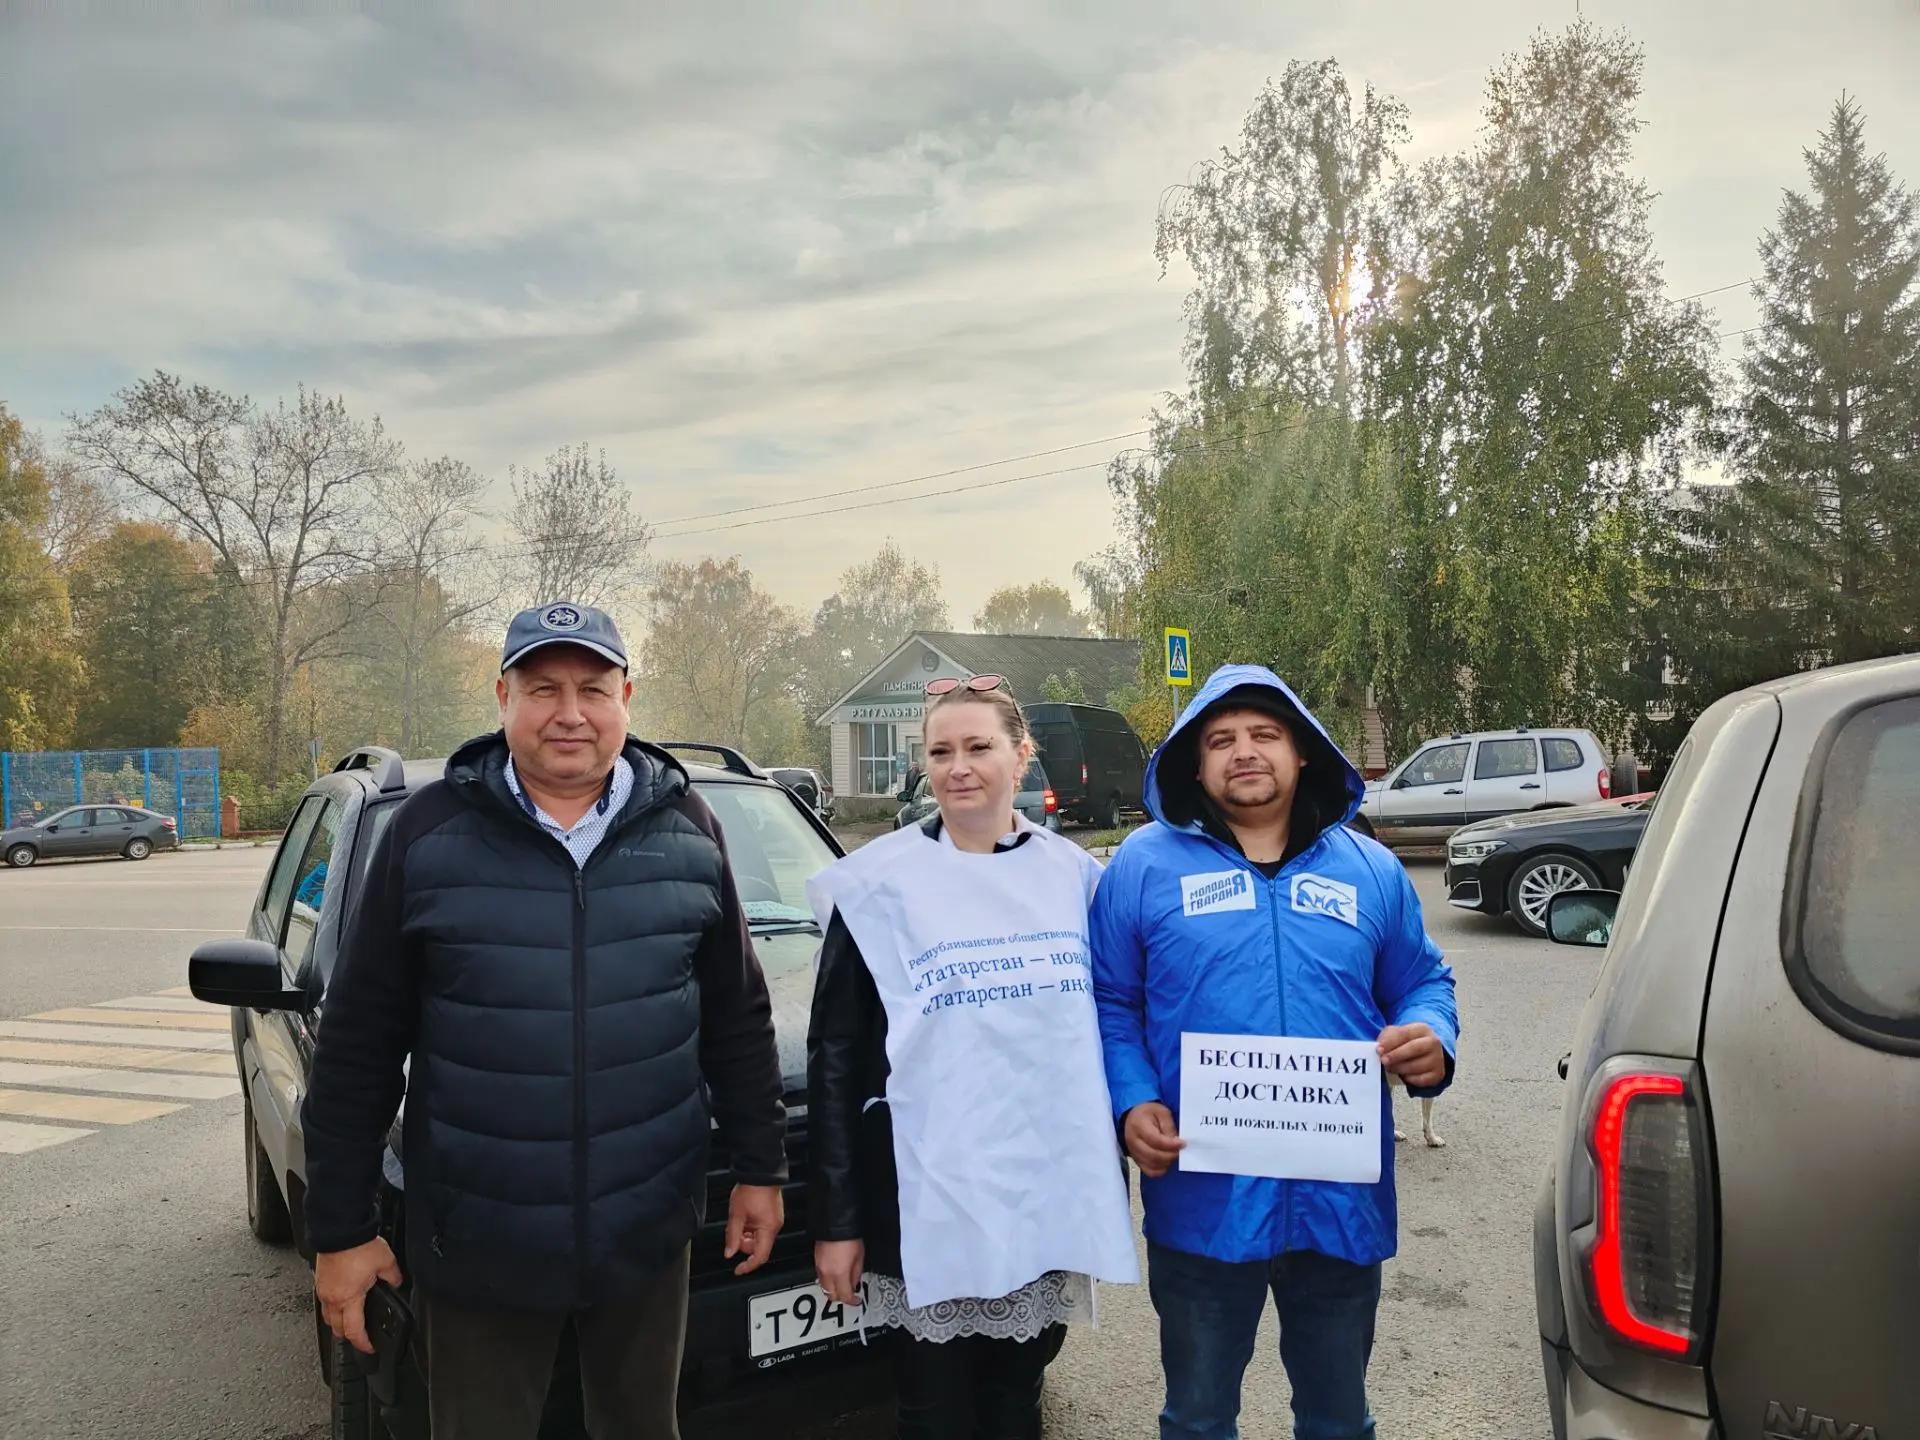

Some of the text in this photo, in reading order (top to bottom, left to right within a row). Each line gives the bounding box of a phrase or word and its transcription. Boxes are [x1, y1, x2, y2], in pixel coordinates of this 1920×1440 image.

[851, 706, 925, 719] РИТУАЛЬНЫ
[908, 935, 1006, 970] Республиканское
[914, 955, 1025, 992] «Татарстан
[922, 982, 1033, 1017] «Татарстан
[1199, 1049, 1367, 1075] БЕСПЛАТНАЯ
[1214, 1081, 1349, 1105] ДОСТАВКА
[1200, 1115, 1364, 1135] для пожилых людей
